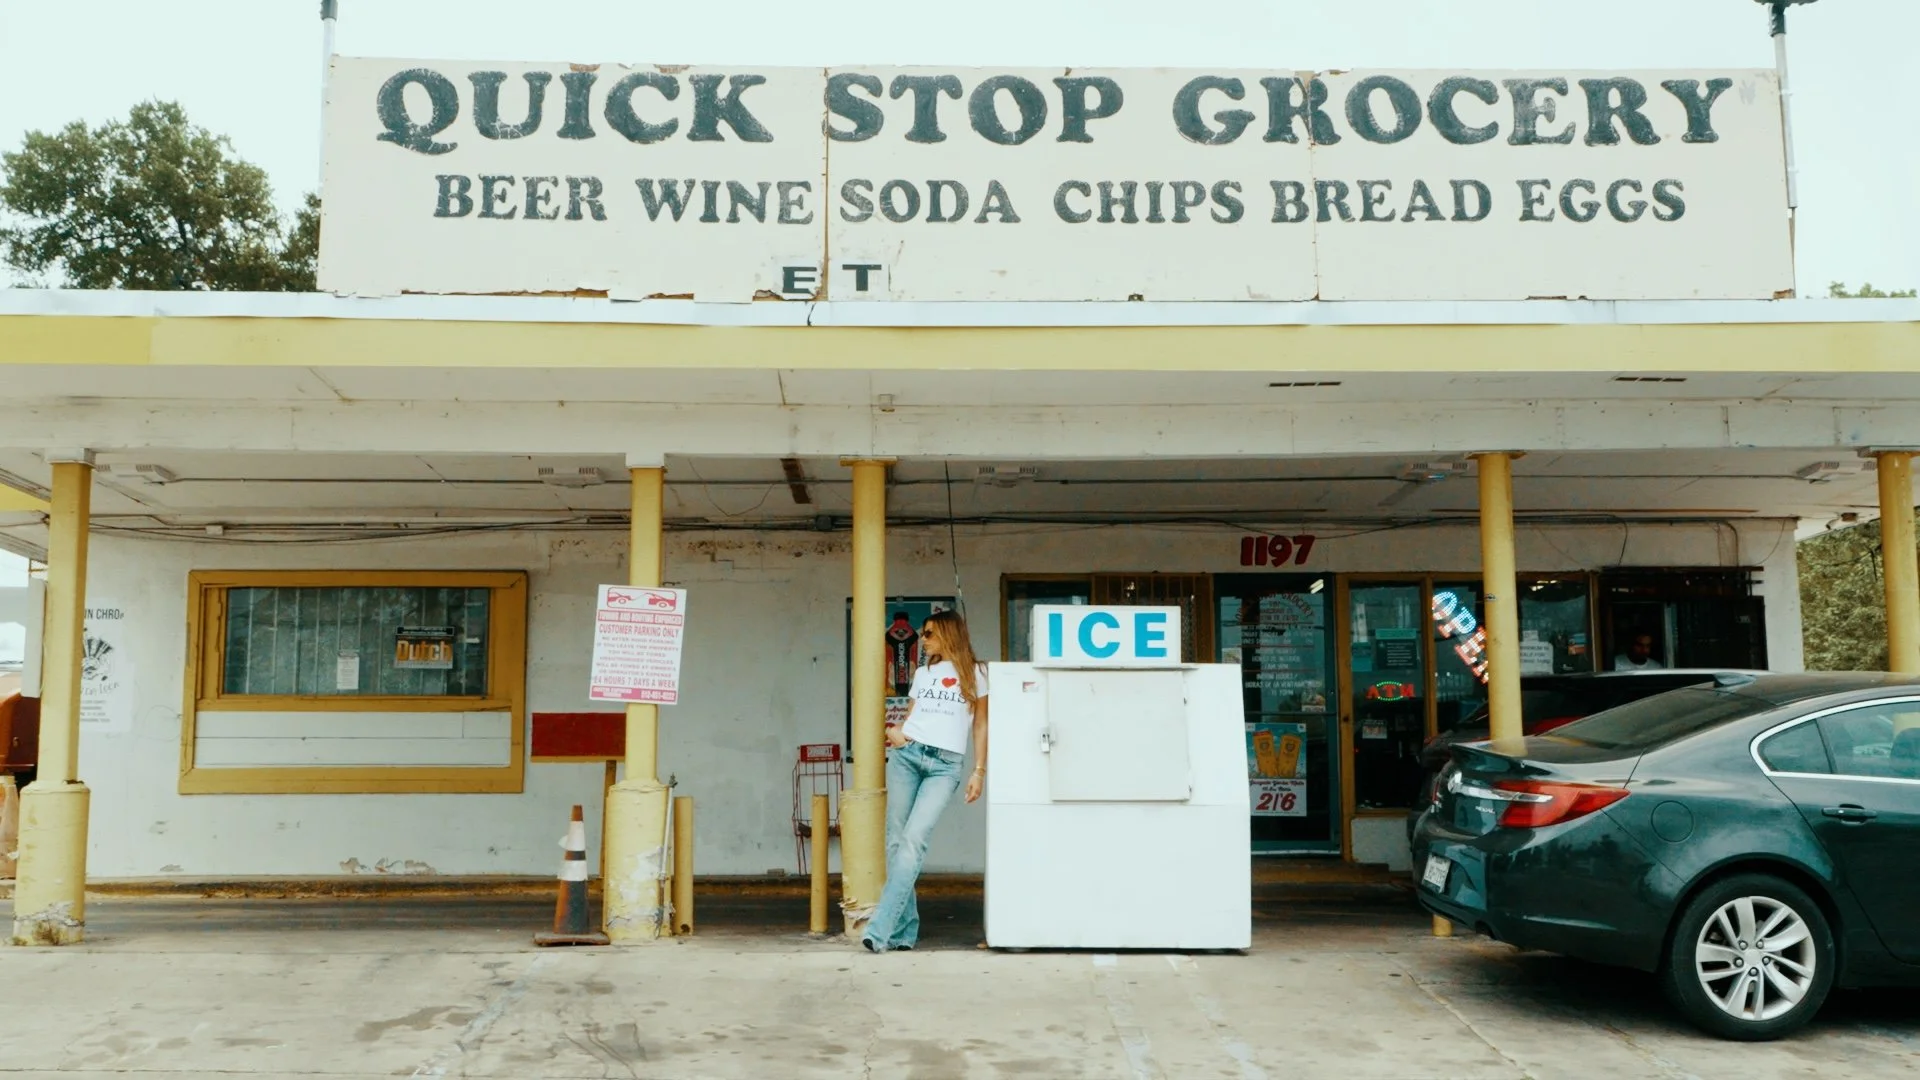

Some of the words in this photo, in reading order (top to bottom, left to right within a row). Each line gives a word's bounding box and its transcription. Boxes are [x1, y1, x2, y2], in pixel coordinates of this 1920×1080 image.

[376, 68, 773, 155] QUICK
[824, 75, 1122, 145] STOP
[1173, 76, 1733, 147] GROCERY
[434, 175, 607, 220] BEER
[636, 179, 812, 224] WINE
[840, 179, 1020, 224] SODA
[1054, 180, 1245, 224] CHIPS
[1270, 179, 1492, 223] BREAD
[1518, 179, 1686, 223] EGGS
[1240, 535, 1316, 567] 1197
[599, 624, 633, 635] CUSTOMER
[634, 626, 661, 637] PARKING
[662, 628, 680, 638] ONLY
[1048, 611, 1167, 658] ICE
[396, 640, 453, 663] Dutch
[594, 676, 602, 684] 24
[603, 676, 626, 685] HOURS
[627, 677, 632, 685] 7
[633, 678, 650, 687] DAYS
[651, 680, 656, 688] A
[658, 680, 676, 689] WEEK
[1366, 683, 1416, 699] ATM
[917, 688, 966, 704] PARIS
